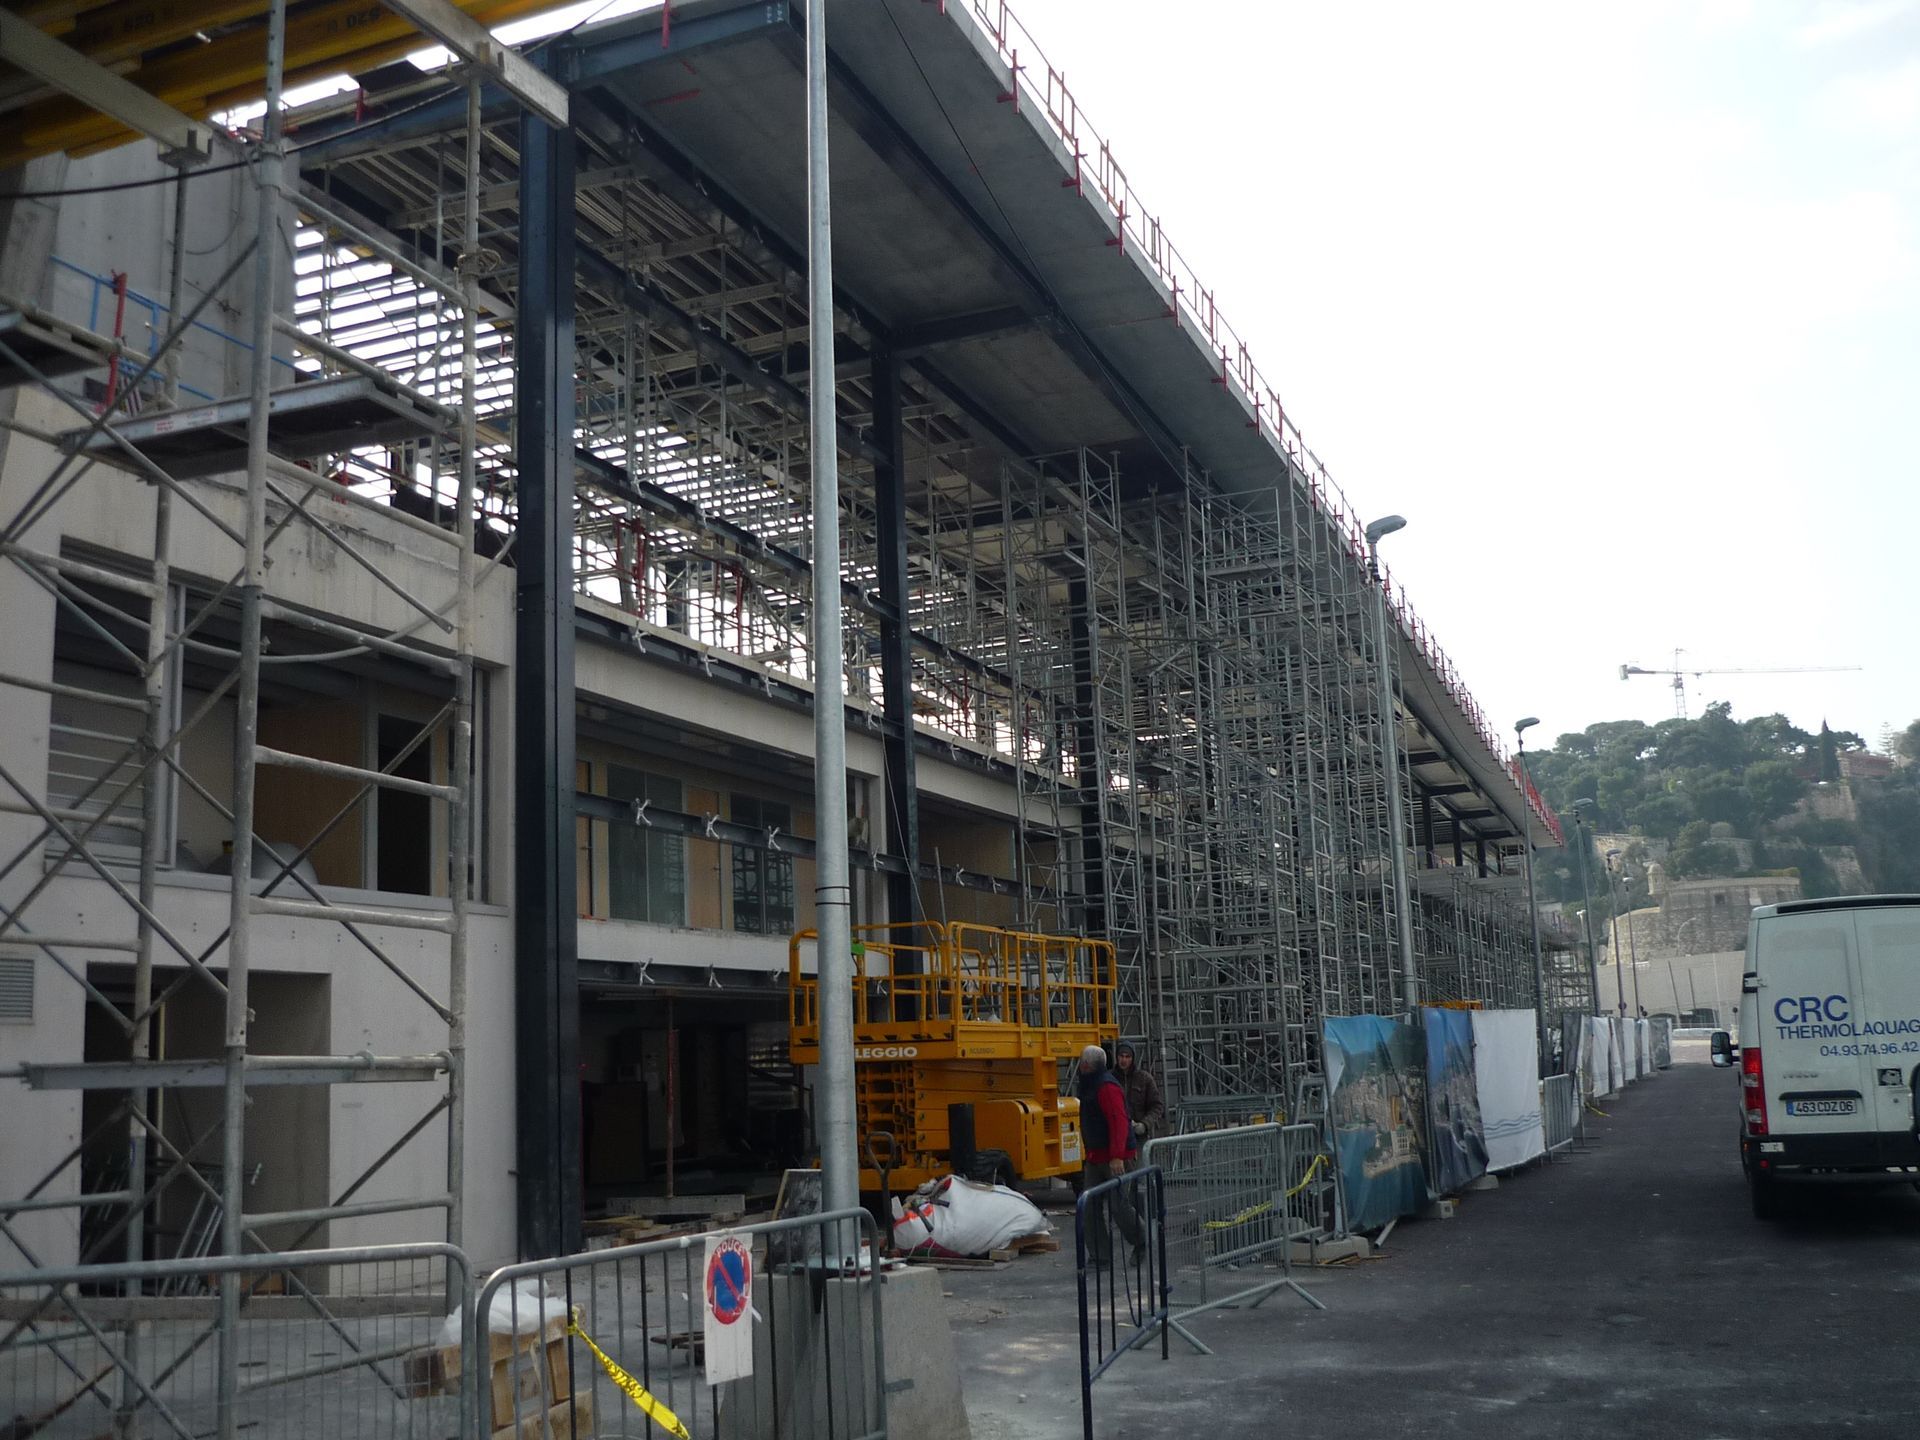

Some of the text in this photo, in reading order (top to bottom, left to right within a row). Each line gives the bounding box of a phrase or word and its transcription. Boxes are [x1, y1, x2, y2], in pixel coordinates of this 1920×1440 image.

[1774, 995, 1848, 1024] CRC
[1820, 1041, 1919, 1056] 04.93.74.96.42
[1795, 1100, 1853, 1113] 463 CDZ 06
